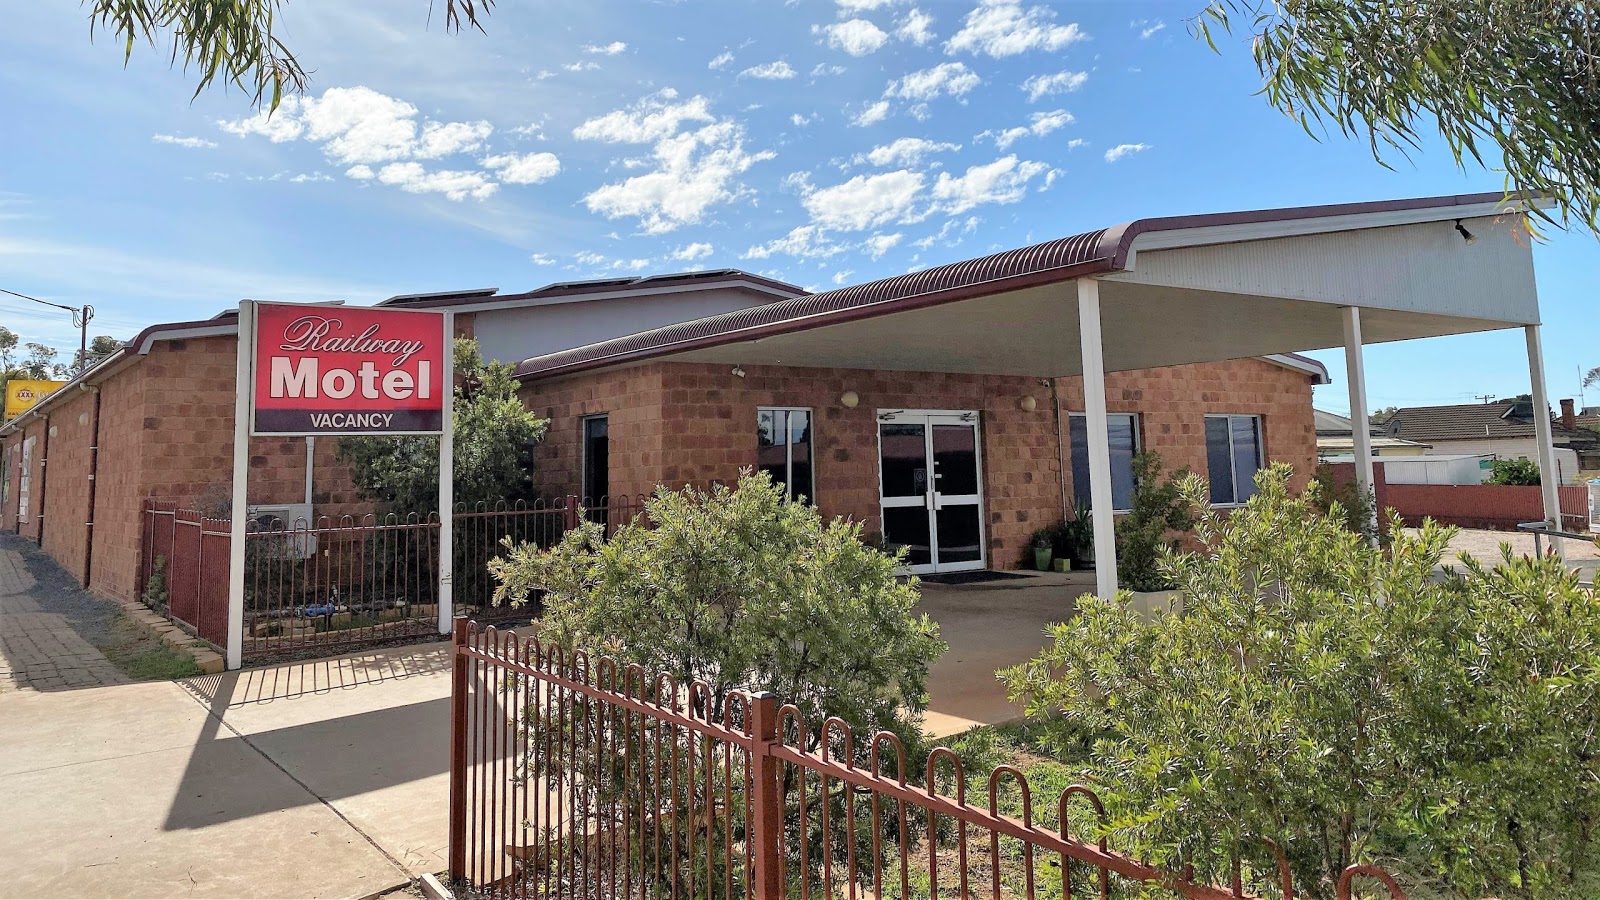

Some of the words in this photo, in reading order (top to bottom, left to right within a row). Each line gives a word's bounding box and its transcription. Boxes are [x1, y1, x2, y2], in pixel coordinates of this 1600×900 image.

[279, 315, 424, 367] Railway
[270, 356, 431, 399] Motel
[309, 413, 393, 428] VACANCY
